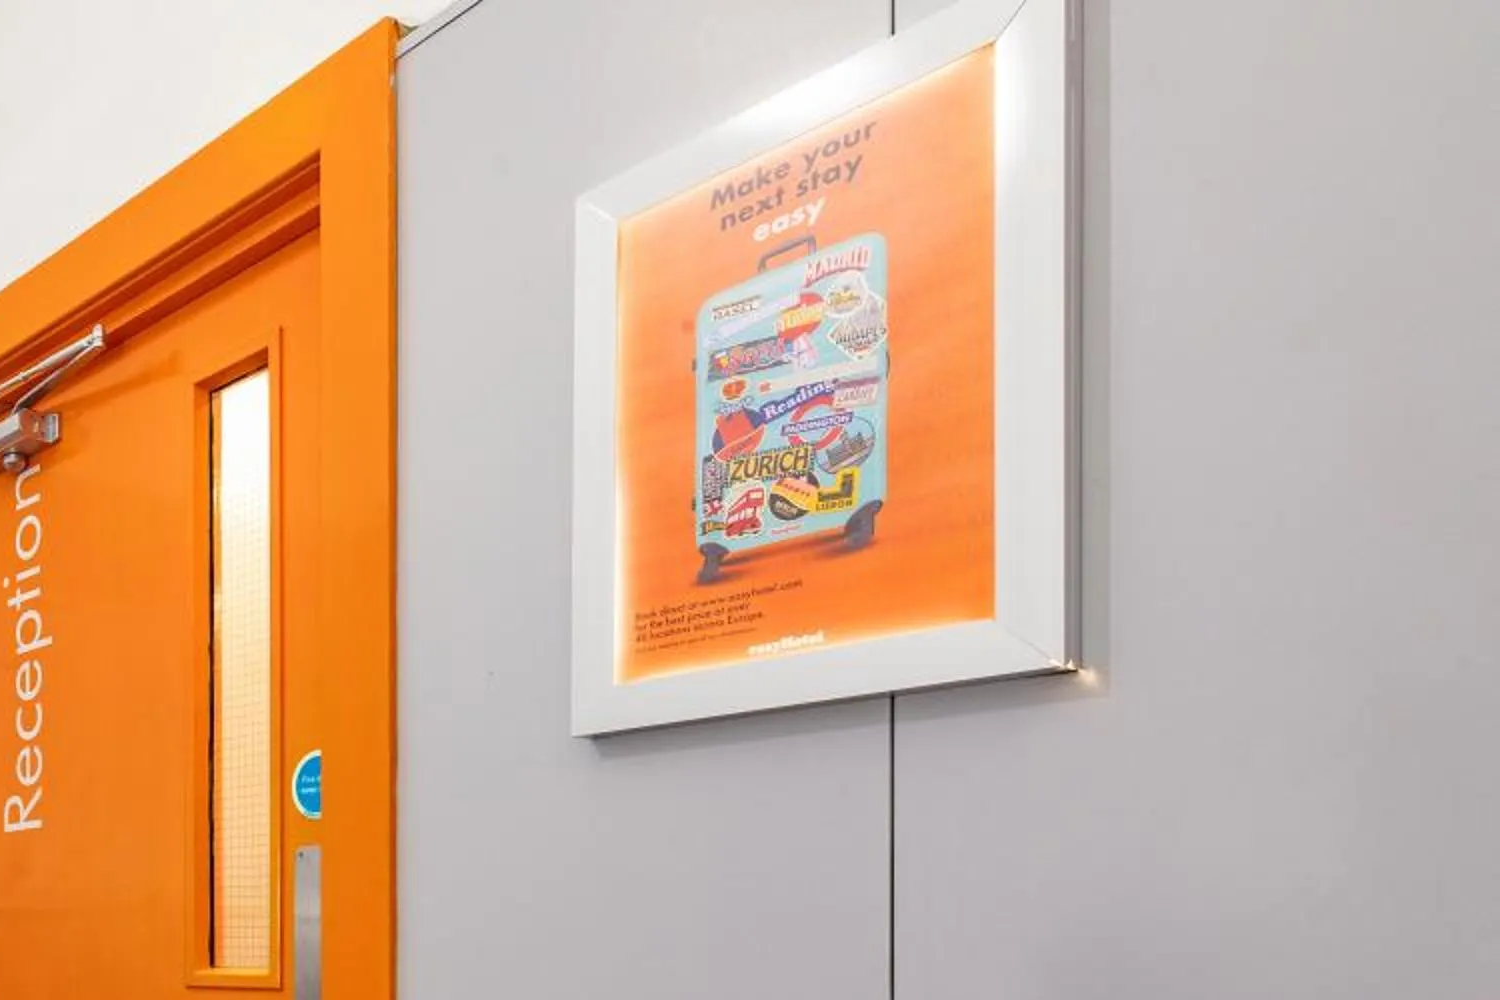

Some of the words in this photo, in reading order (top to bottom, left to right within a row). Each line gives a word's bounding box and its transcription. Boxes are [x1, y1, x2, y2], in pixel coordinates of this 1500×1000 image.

[711, 161, 791, 211] Make
[803, 122, 877, 174] your
[721, 187, 785, 231] next
[796, 154, 863, 198] stay
[753, 198, 826, 241] easy
[762, 380, 838, 420] Reading
[4, 463, 53, 834] Reception
